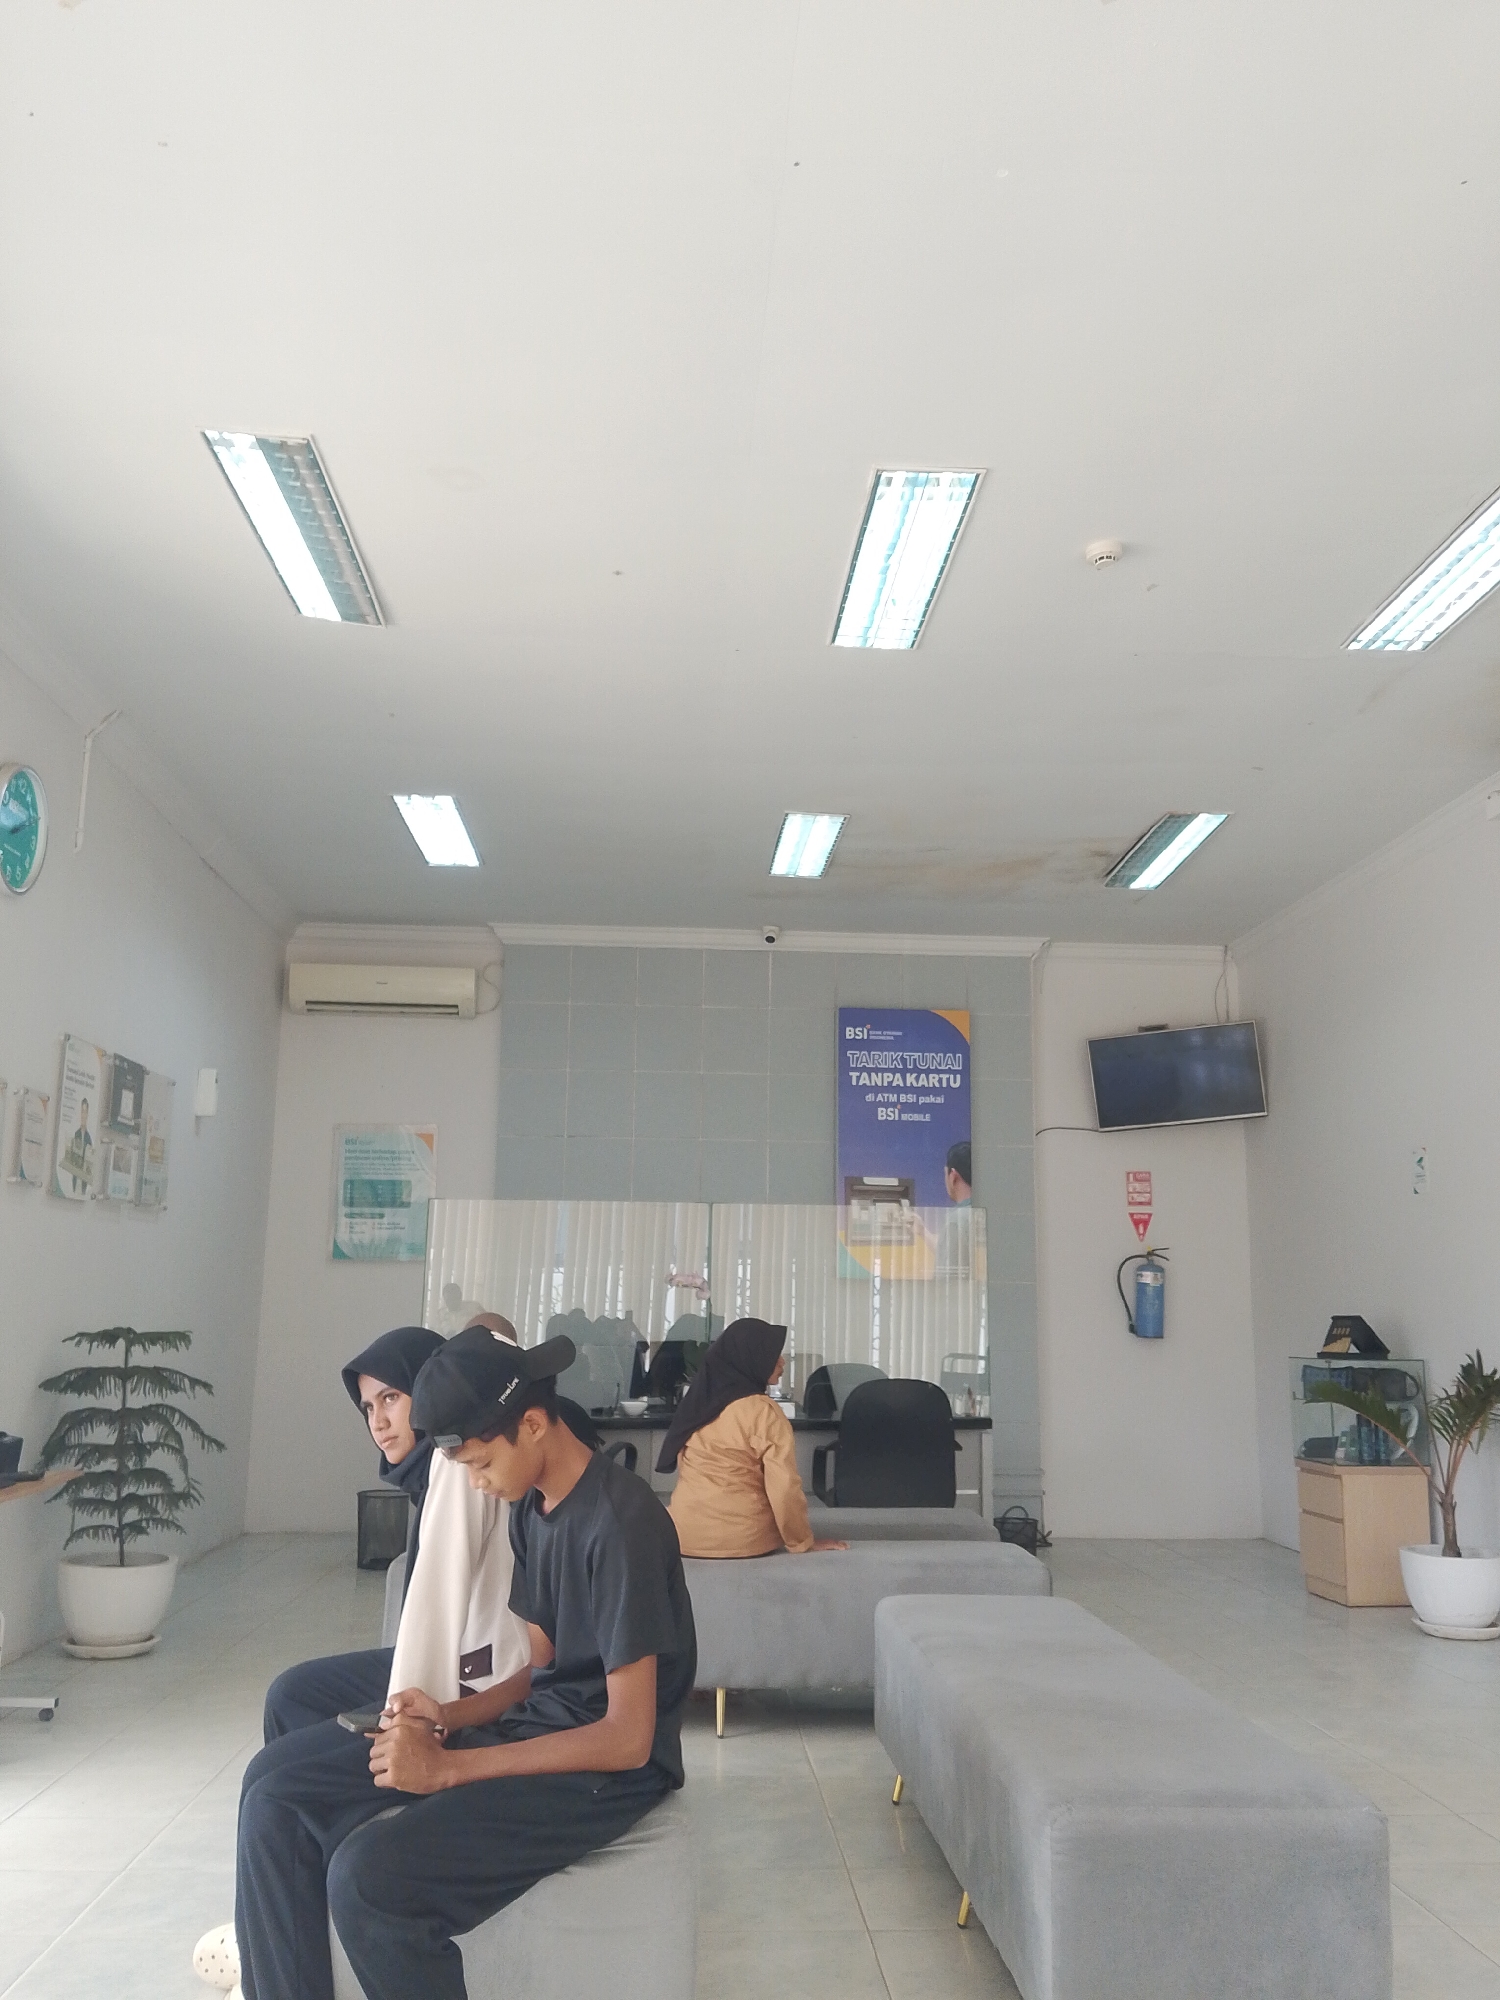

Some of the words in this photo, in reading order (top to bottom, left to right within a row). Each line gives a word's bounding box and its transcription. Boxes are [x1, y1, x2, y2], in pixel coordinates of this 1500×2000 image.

[845, 1027, 868, 1039] BSI
[847, 1051, 903, 1068] TARIK
[903, 1052, 962, 1070] TUNAI
[849, 1072, 904, 1087] TANPA
[906, 1073, 960, 1088] KARTU
[865, 1093, 875, 1102] di
[876, 1093, 898, 1103] ATM
[899, 1094, 917, 1103] BSI
[918, 1094, 945, 1105] pakai
[877, 1108, 898, 1120] BSI
[901, 1113, 931, 1122] MOBILE
